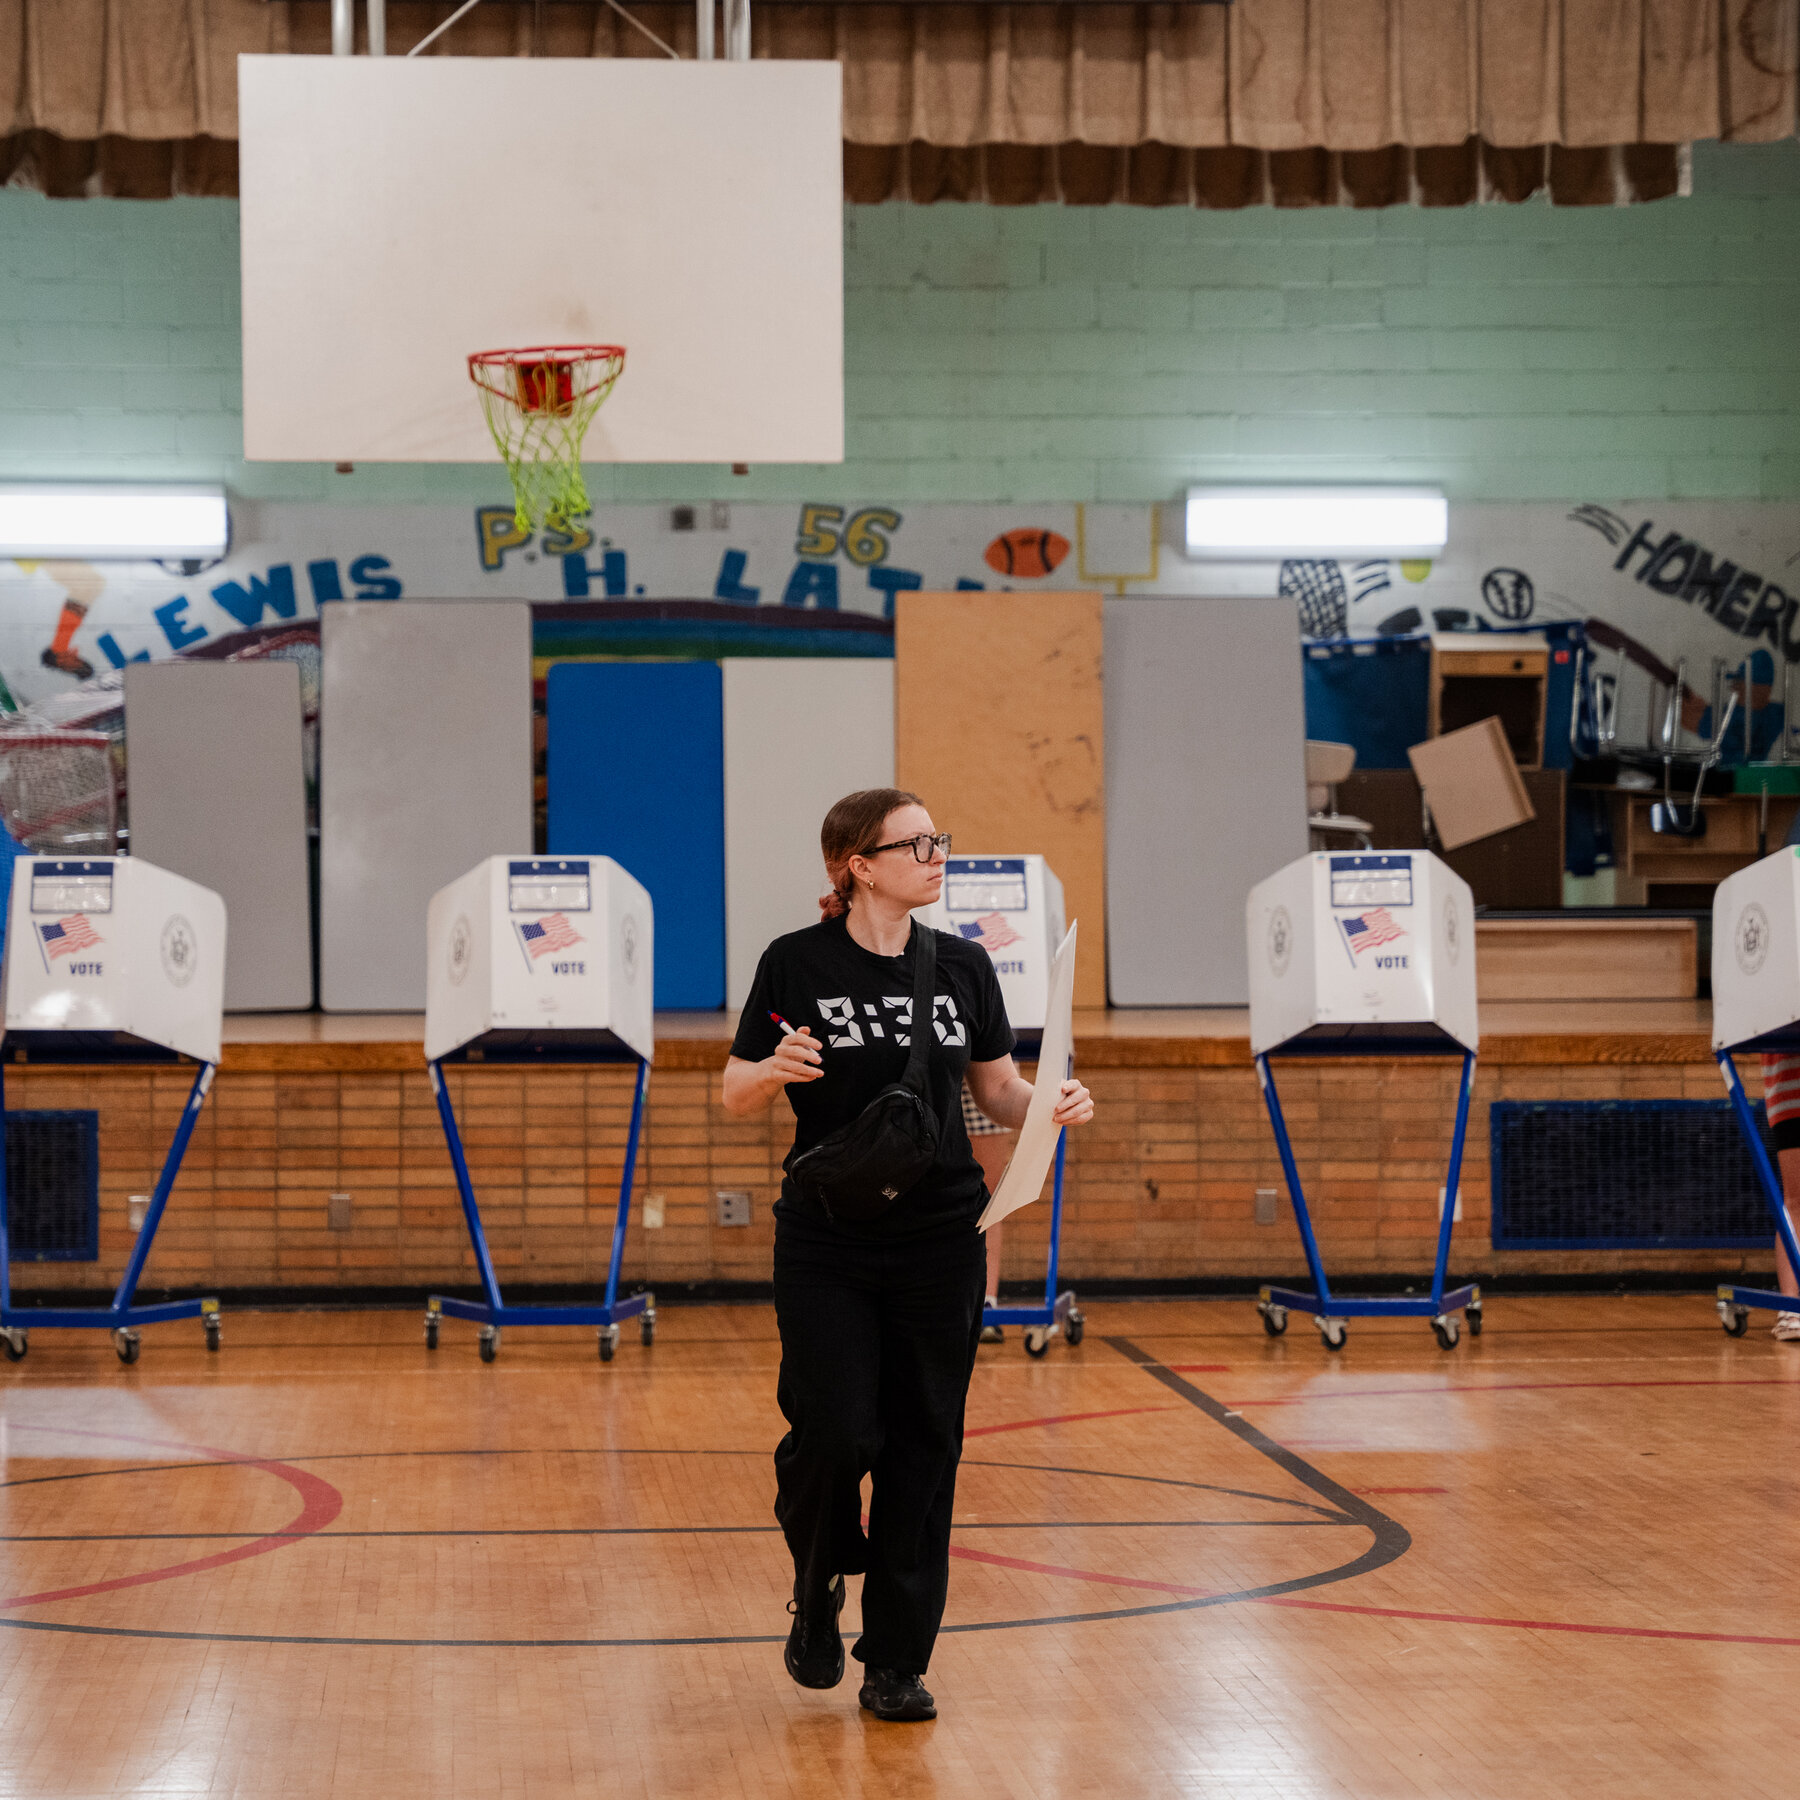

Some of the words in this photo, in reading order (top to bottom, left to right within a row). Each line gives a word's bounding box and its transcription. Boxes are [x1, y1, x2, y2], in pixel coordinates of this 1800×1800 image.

[796, 503, 902, 567] 56
[97, 554, 402, 669] LEWIS
[563, 550, 647, 600] H.
[70, 962, 103, 975] VOTE
[551, 961, 586, 975] VOTE
[1375, 956, 1409, 969] VOTE
[816, 995, 966, 1047] 9:30
